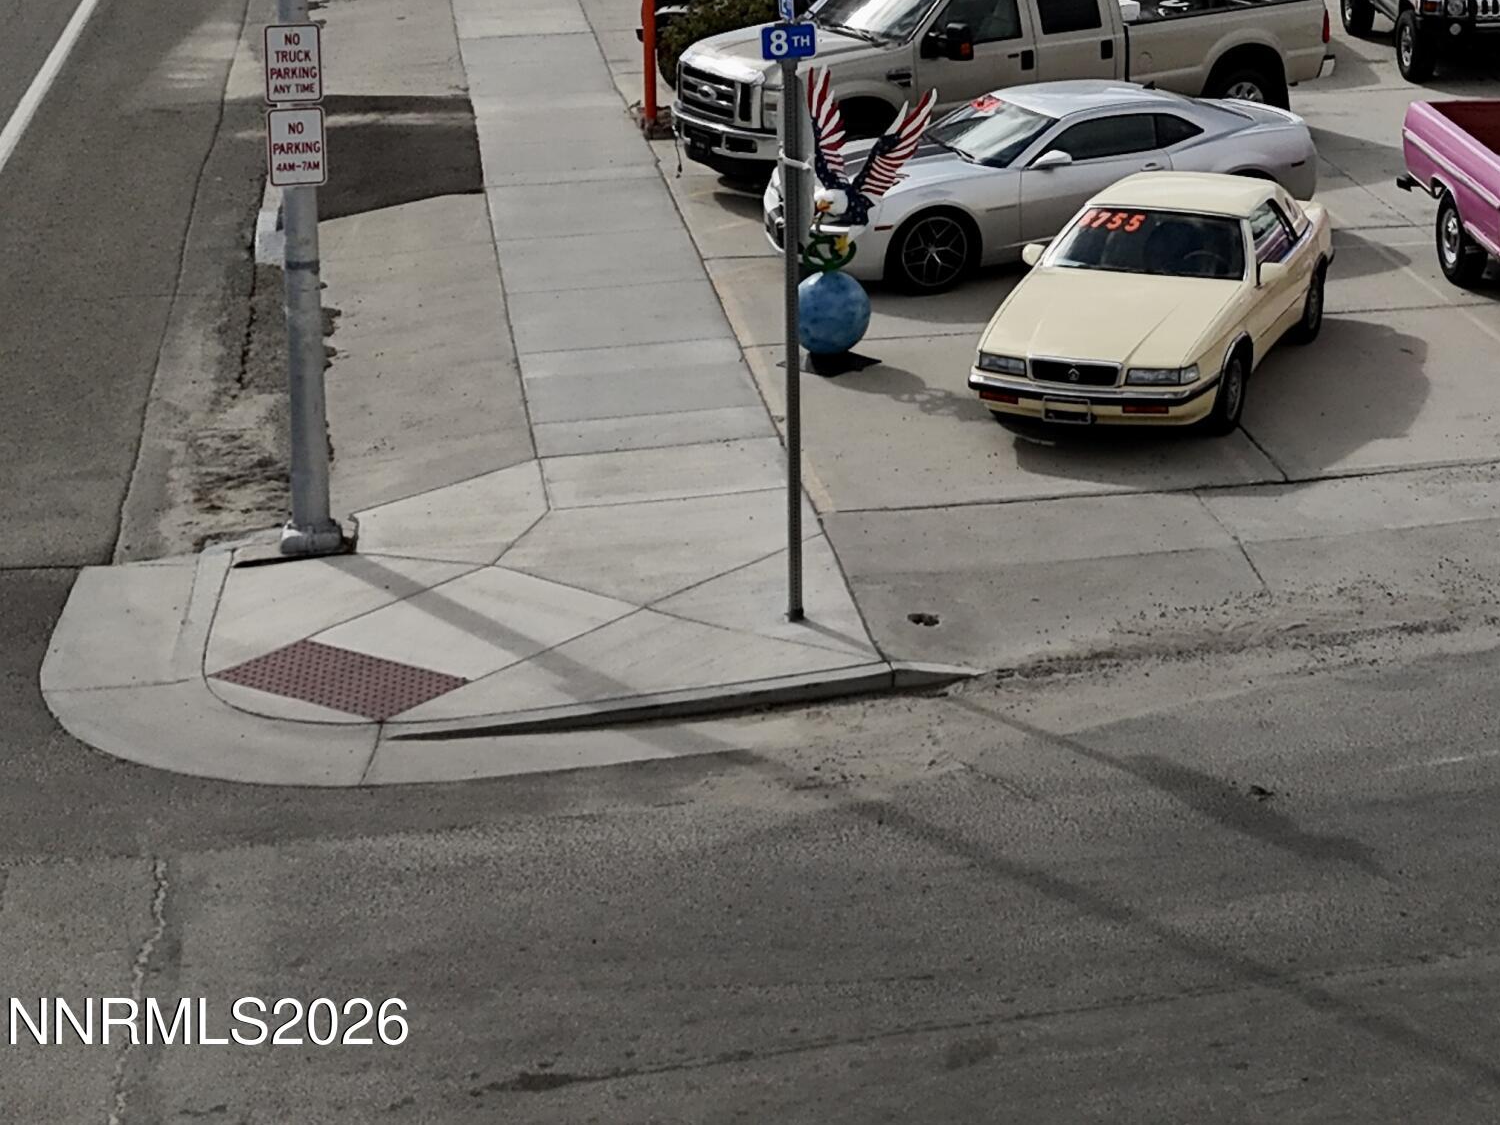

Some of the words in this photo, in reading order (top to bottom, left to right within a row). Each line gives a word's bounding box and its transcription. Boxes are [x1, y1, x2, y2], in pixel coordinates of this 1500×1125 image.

[284, 33, 300, 46] NO
[274, 50, 312, 63] TRUCK
[270, 66, 317, 80] PARKING
[273, 84, 291, 94] ANY
[295, 83, 315, 93] TIME
[288, 122, 304, 135] NO
[273, 141, 320, 155] PARKING
[276, 161, 320, 172] 4AM-7AM
